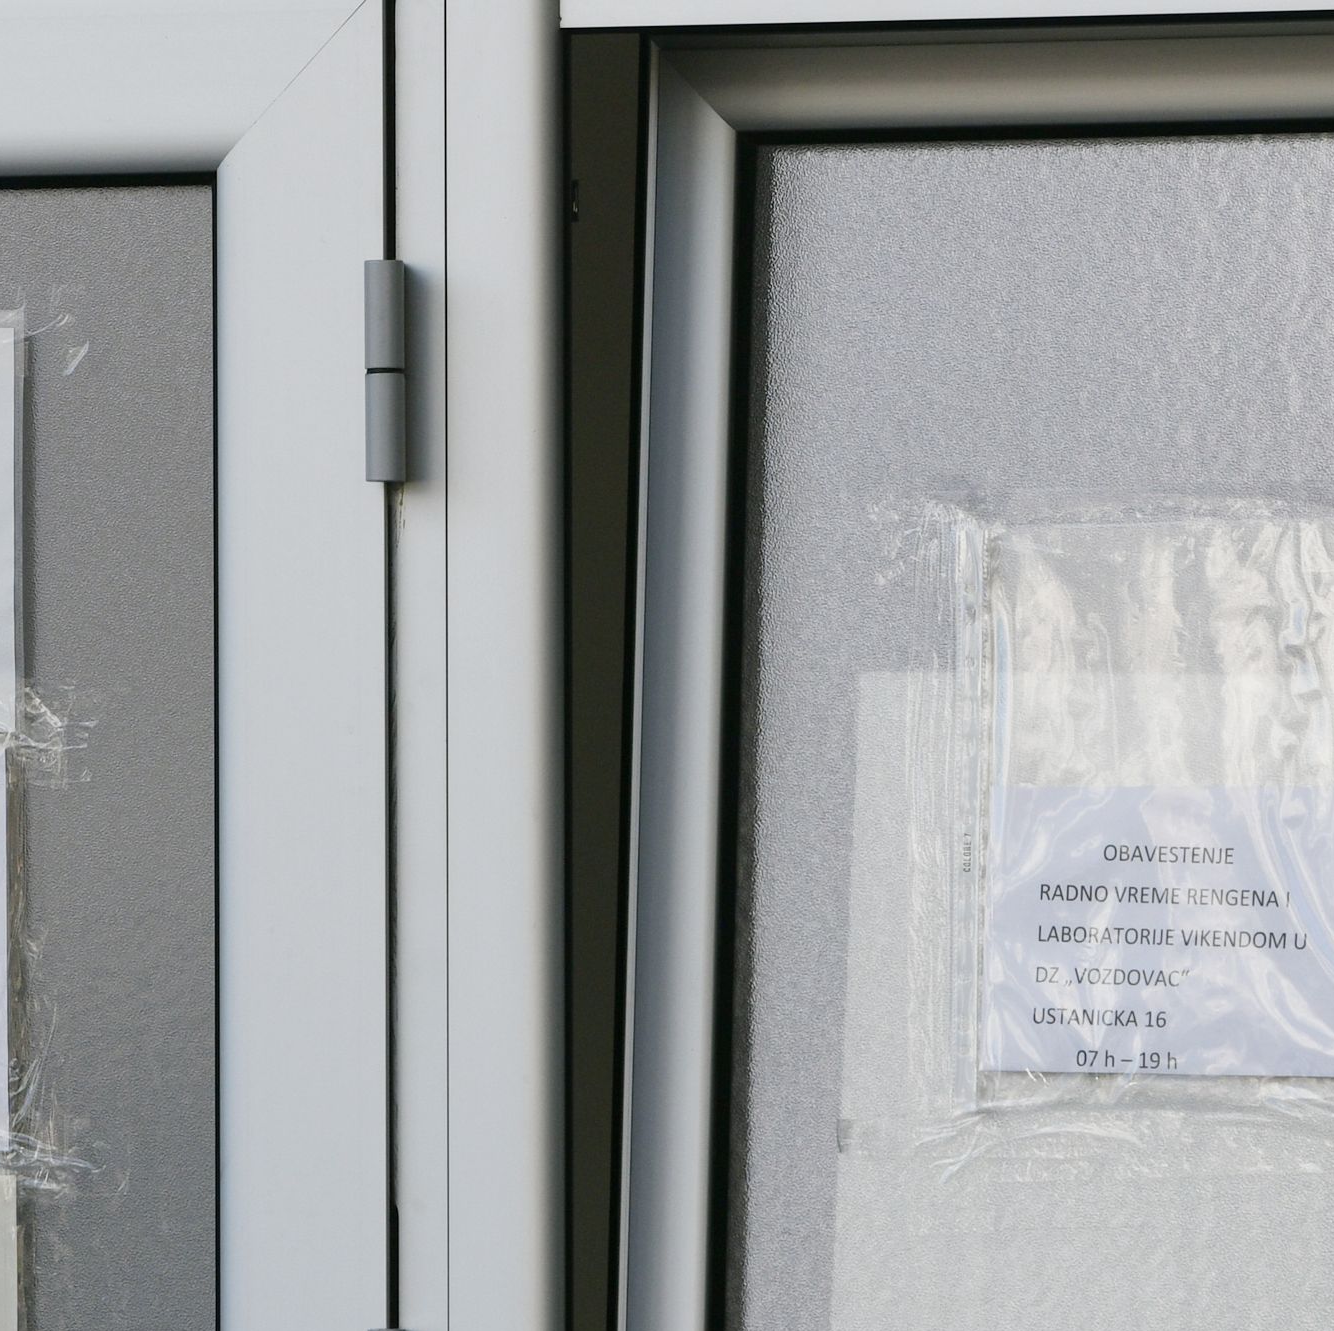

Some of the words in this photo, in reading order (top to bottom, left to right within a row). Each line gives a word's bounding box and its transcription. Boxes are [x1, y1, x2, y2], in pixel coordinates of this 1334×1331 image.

[1102, 844, 1235, 864] OBAVESTENJE
[1040, 883, 1108, 902] RADNO
[1114, 885, 1179, 904] VREME
[1187, 888, 1279, 908] RENGENA
[1286, 891, 1290, 907] I
[1038, 925, 1174, 946] LABORATORIJE
[1180, 929, 1287, 949] VIKENDOM
[1294, 932, 1307, 950] U
[1035, 966, 1059, 983] DZ
[1032, 1007, 1138, 1027] USTANICKA
[1145, 1010, 1166, 1028] 16
[1076, 1049, 1098, 1067] 07
[1104, 1049, 1114, 1067] h
[1138, 1051, 1160, 1069] 19
[1167, 1050, 1177, 1070] h
